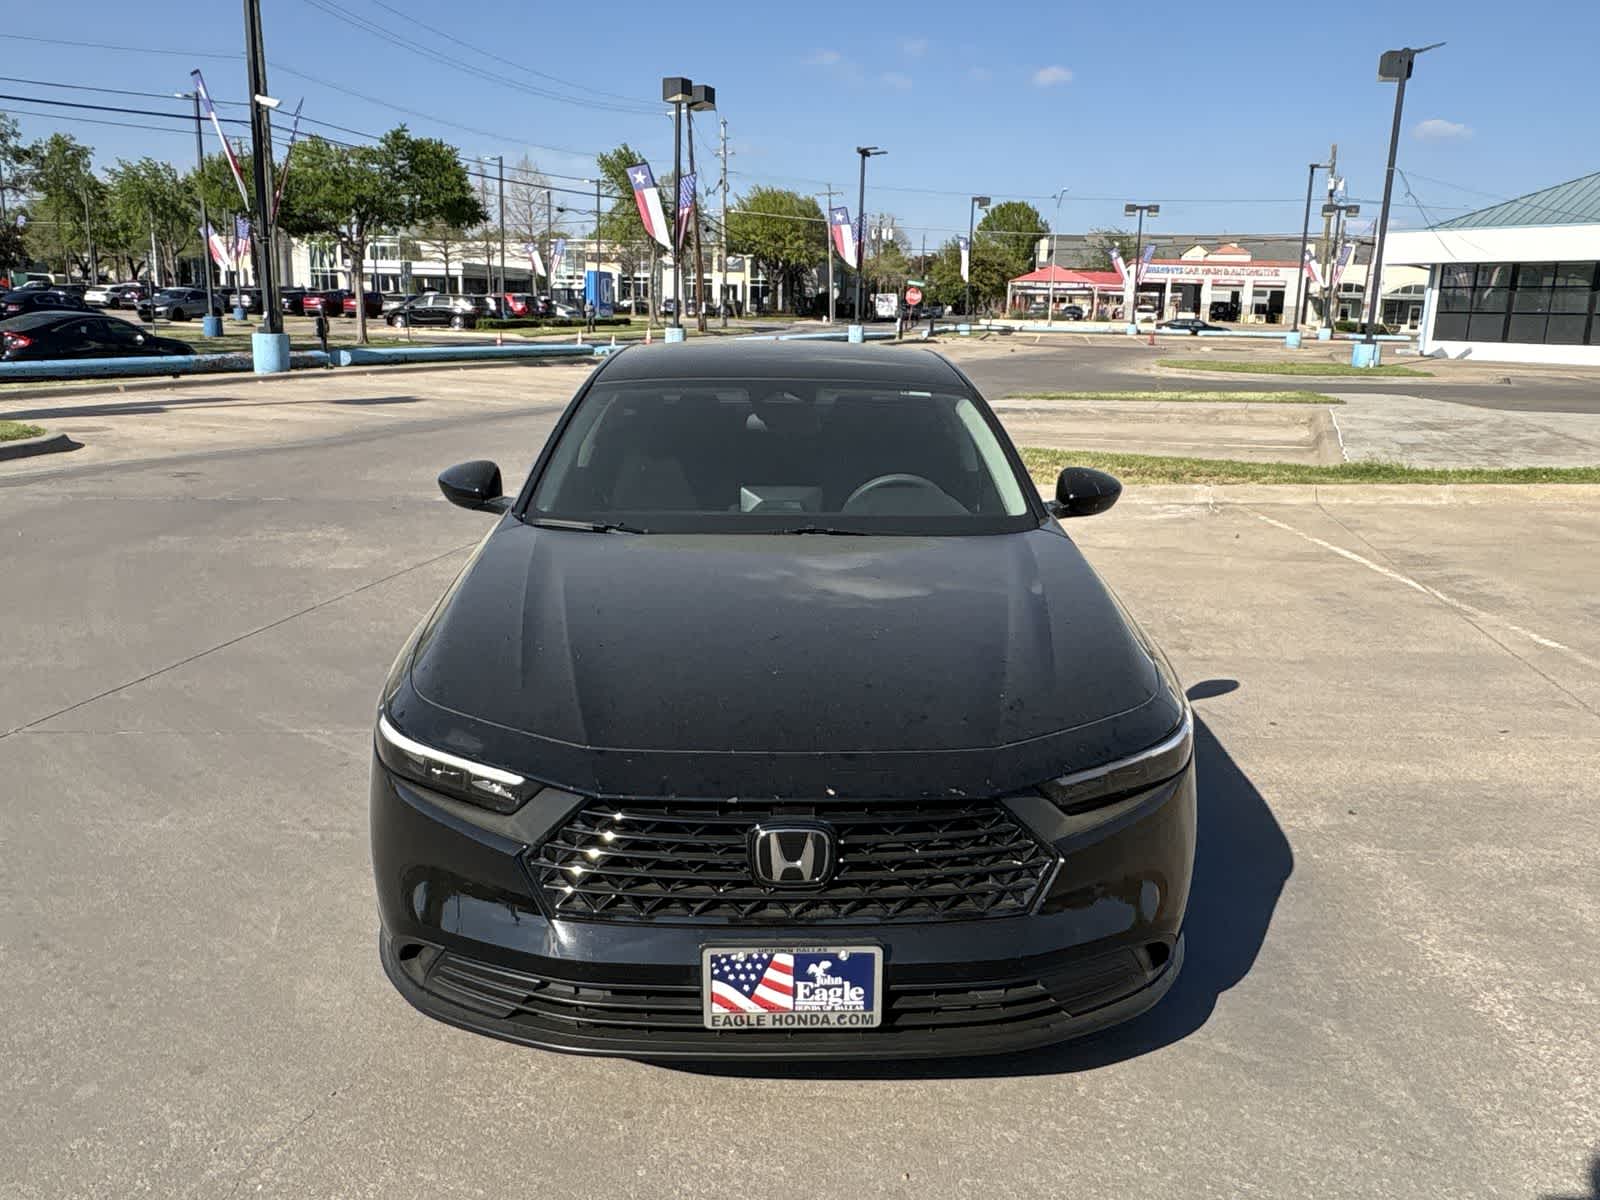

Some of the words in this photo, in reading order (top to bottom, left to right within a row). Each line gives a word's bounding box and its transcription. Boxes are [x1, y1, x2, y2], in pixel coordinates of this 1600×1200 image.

[795, 981, 865, 1006] Eagle
[711, 1014, 766, 1027] EAGLE
[772, 1014, 874, 1026] HONDA.COM
